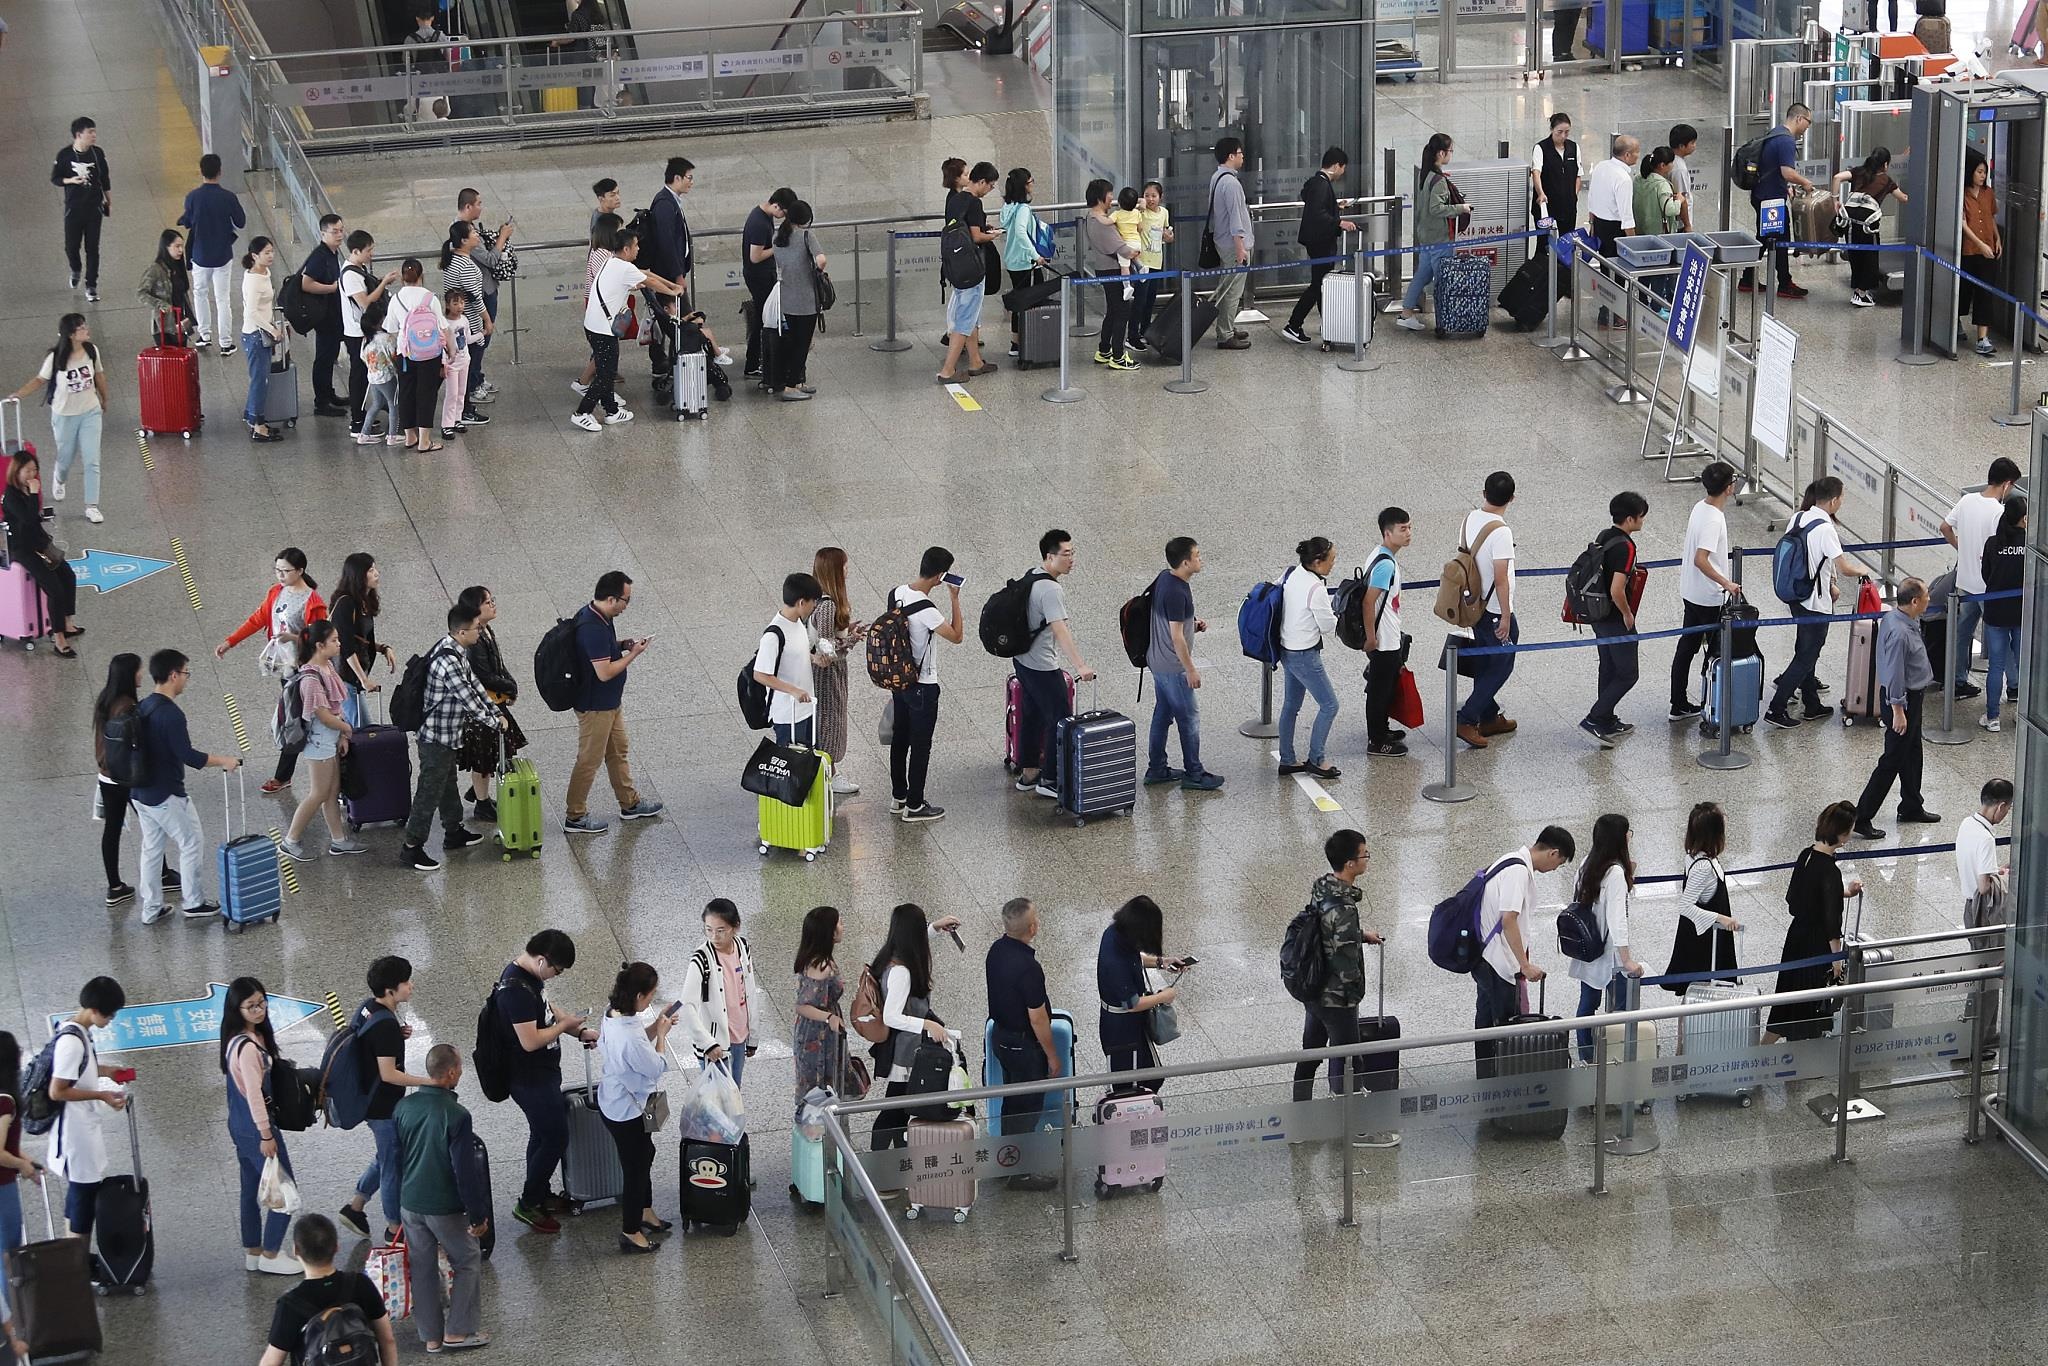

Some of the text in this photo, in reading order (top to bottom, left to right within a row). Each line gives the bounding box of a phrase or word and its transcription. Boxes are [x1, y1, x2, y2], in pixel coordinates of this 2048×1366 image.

[1676, 259, 1698, 341] 治安检查站
[135, 1013, 168, 1038] 售票
[188, 1008, 220, 1034] 安检
